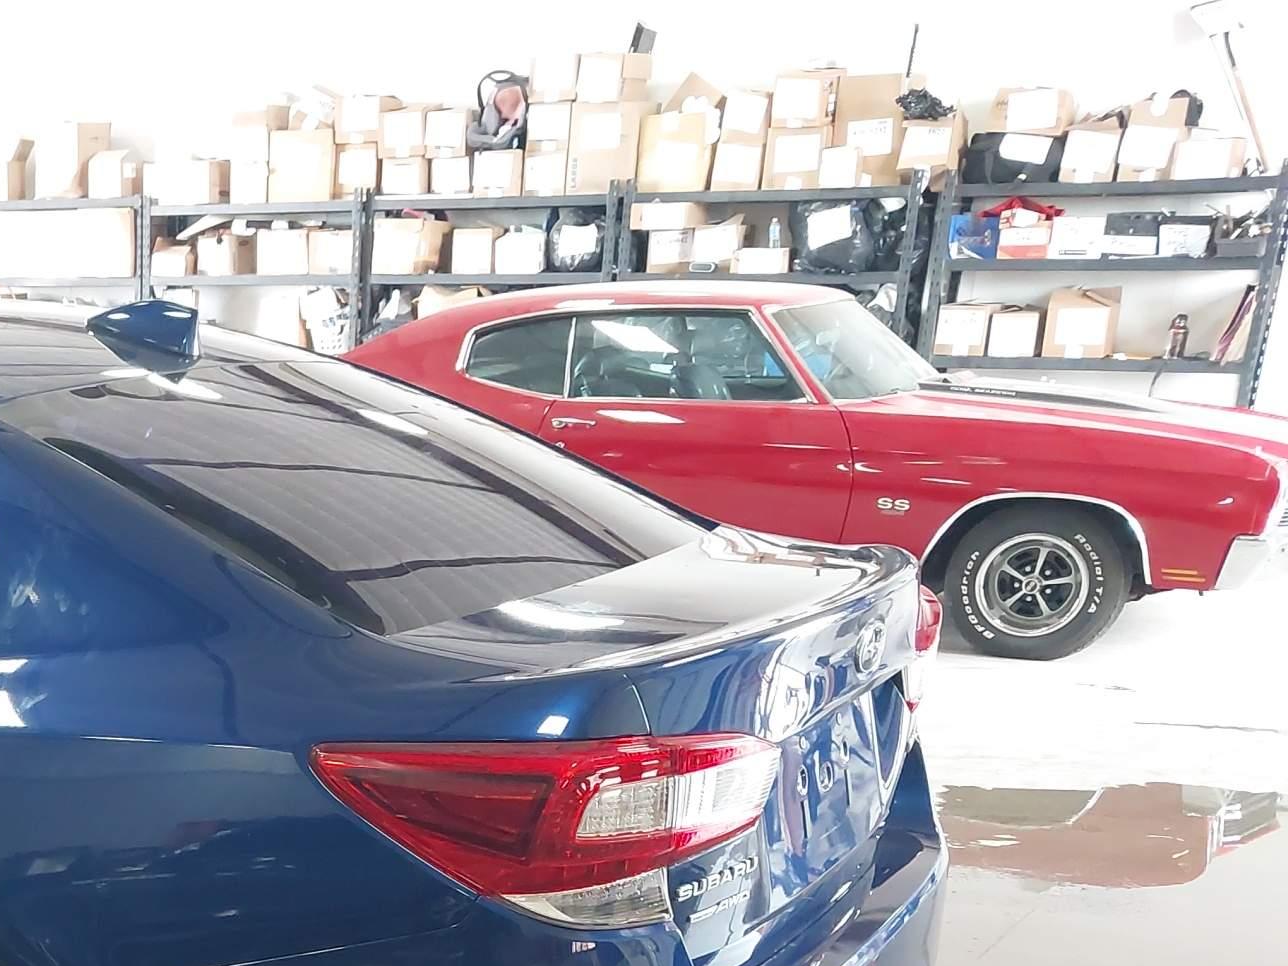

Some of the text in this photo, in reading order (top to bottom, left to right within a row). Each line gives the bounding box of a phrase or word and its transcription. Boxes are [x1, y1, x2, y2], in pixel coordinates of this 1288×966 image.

[877, 497, 910, 511] SS
[960, 551, 996, 640] BFGoodrich
[1074, 534, 1104, 613] Radial T/A
[677, 856, 759, 903] SUBARU
[715, 890, 751, 914] AWD
